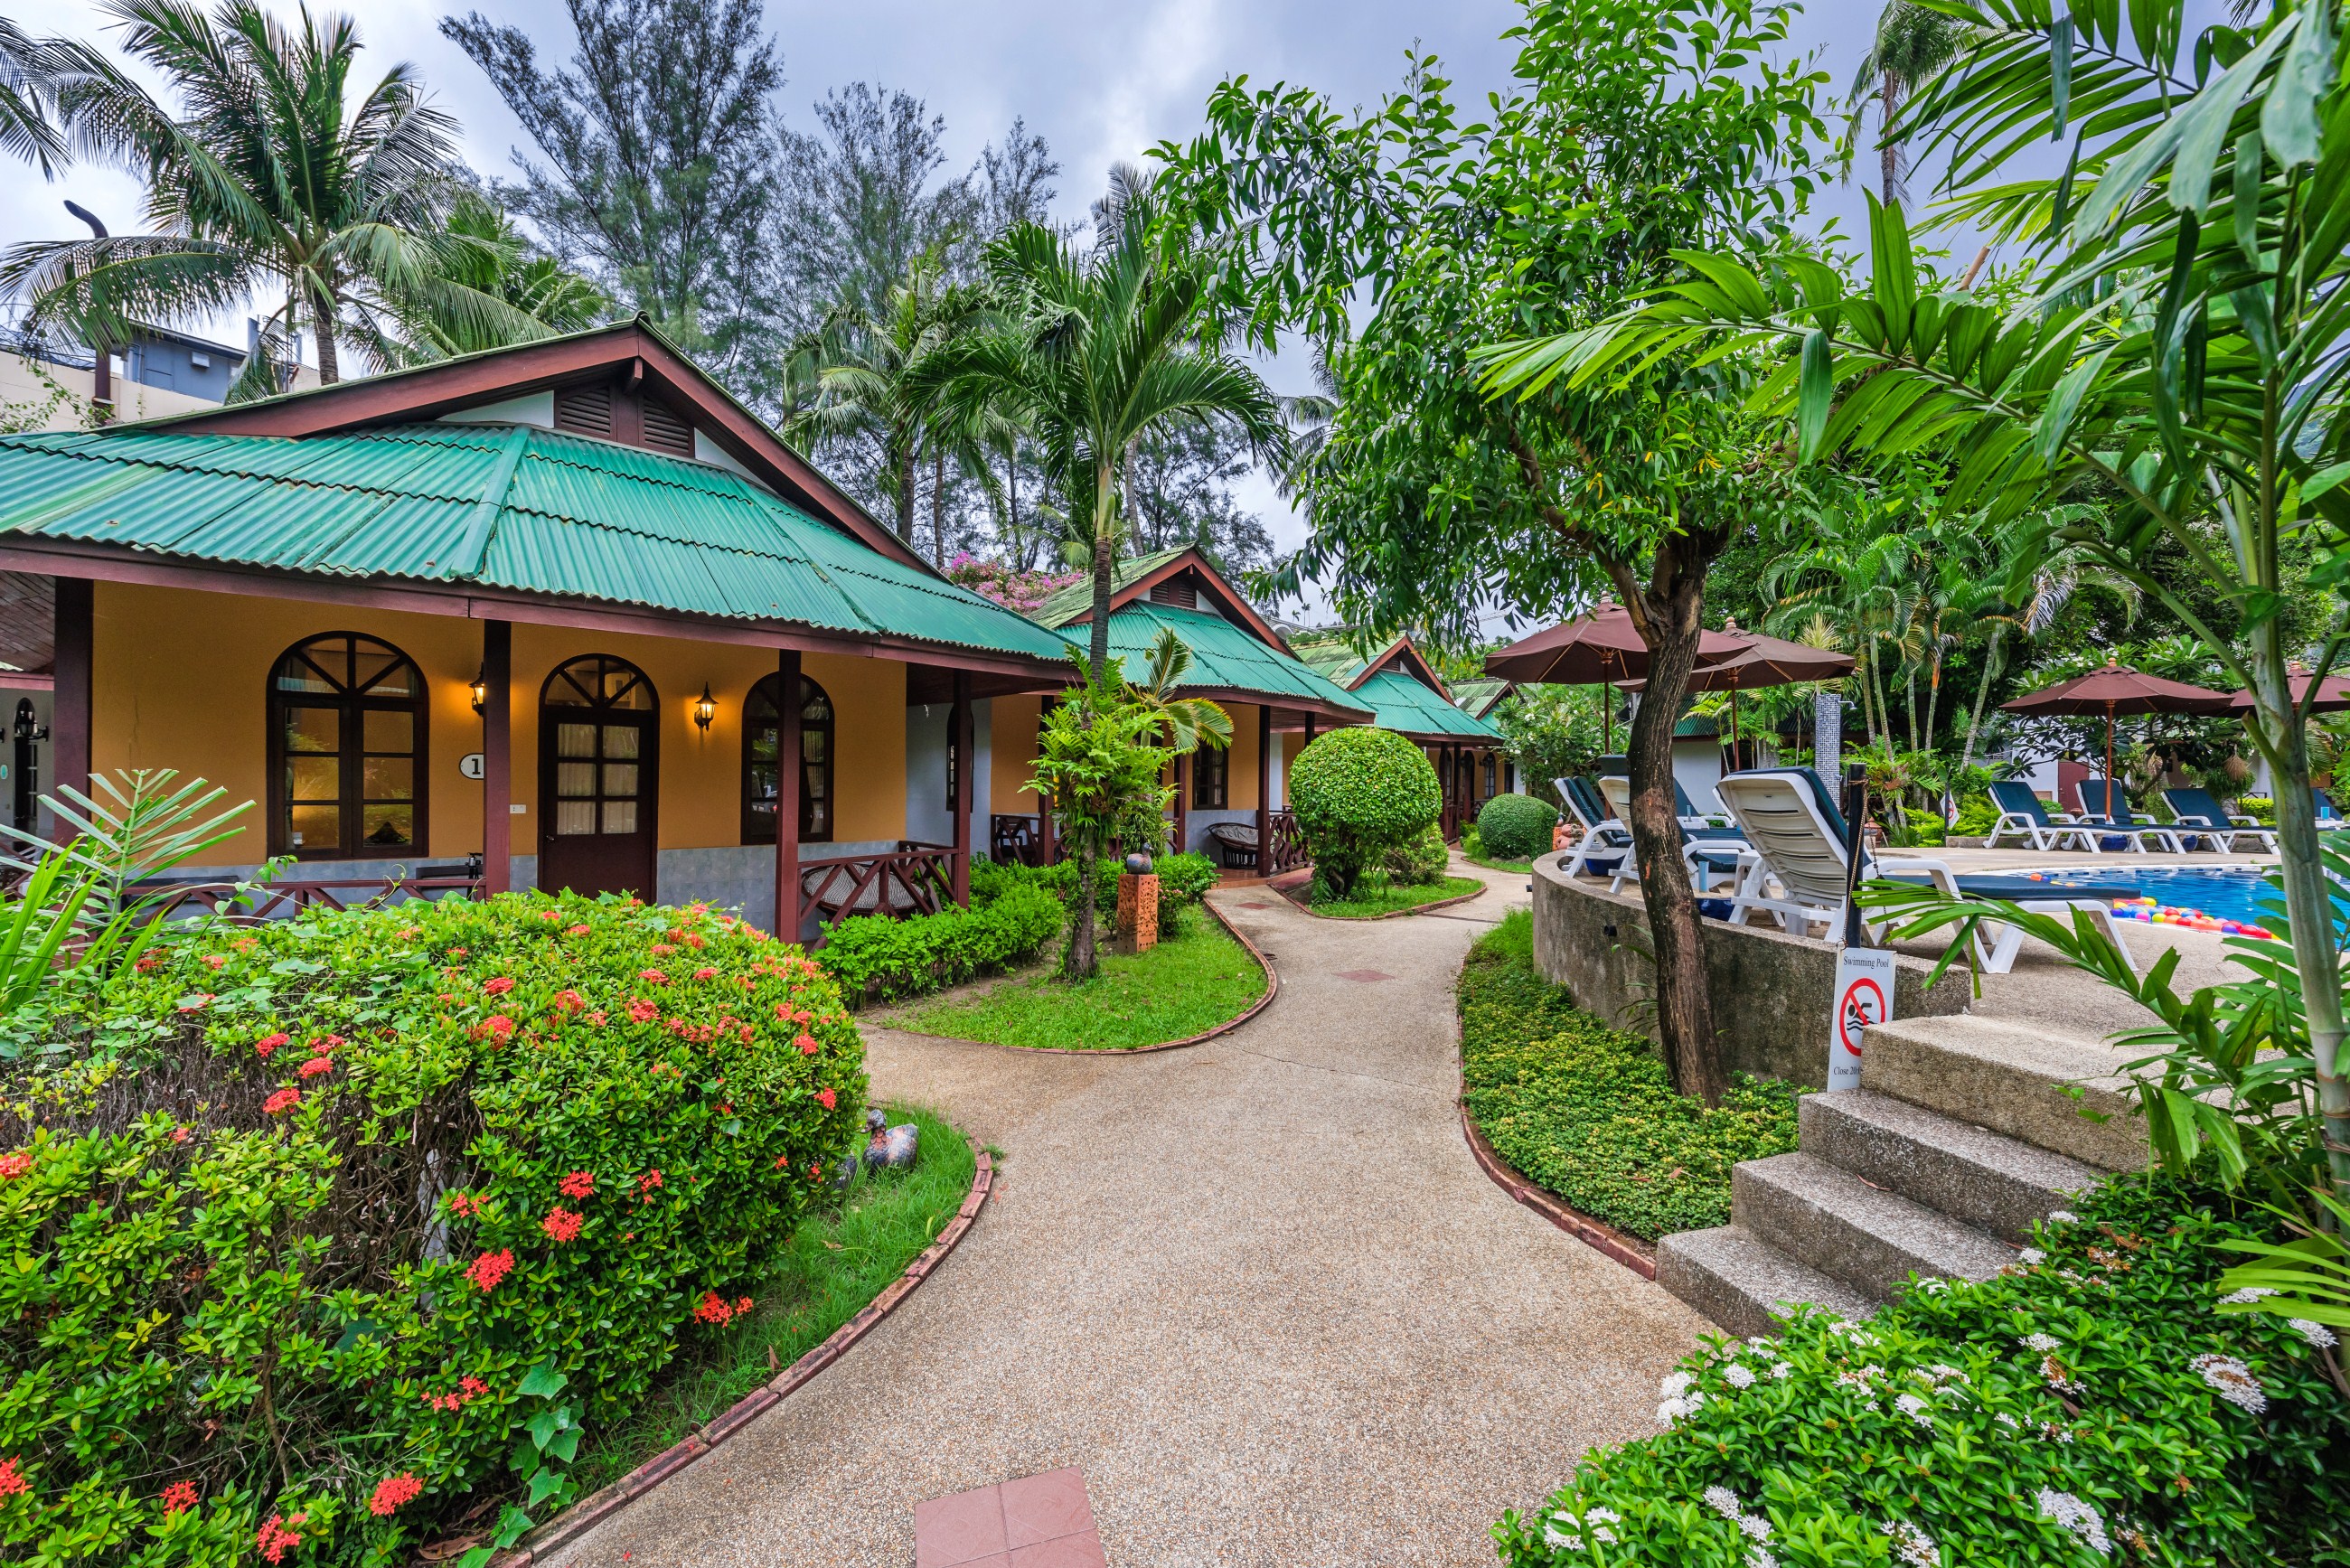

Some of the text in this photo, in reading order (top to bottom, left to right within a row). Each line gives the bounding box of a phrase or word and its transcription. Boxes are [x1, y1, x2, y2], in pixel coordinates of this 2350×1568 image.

[471, 758, 481, 775] 1
[1844, 955, 1889, 969] Swimming Pool
[1833, 1066, 1849, 1075] Close
